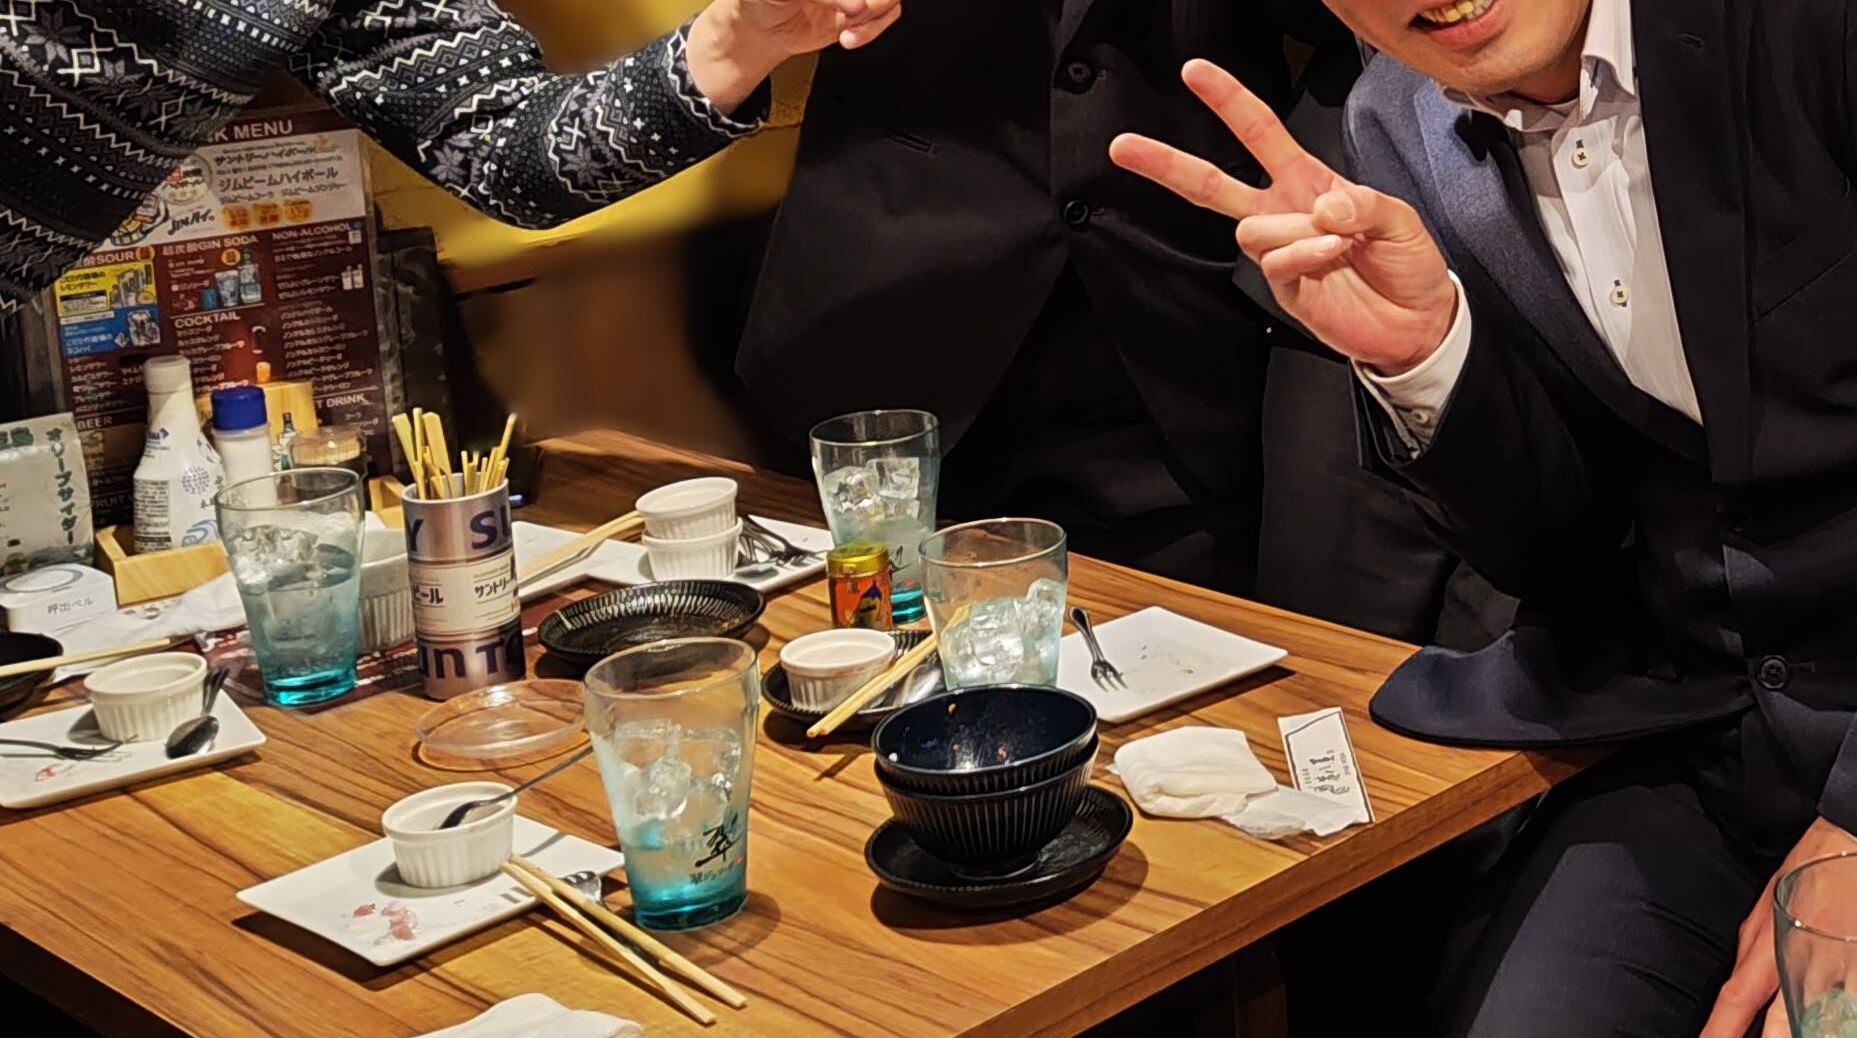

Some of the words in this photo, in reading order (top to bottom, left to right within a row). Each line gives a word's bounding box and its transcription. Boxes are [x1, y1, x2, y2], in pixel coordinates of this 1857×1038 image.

[233, 119, 293, 140] MENU
[219, 166, 339, 192] ジムビームハイボール
[174, 310, 241, 329] COCKTAIL
[325, 392, 369, 409] DRINK
[77, 416, 113, 430] BEER
[47, 596, 94, 615] 呼出ベル
